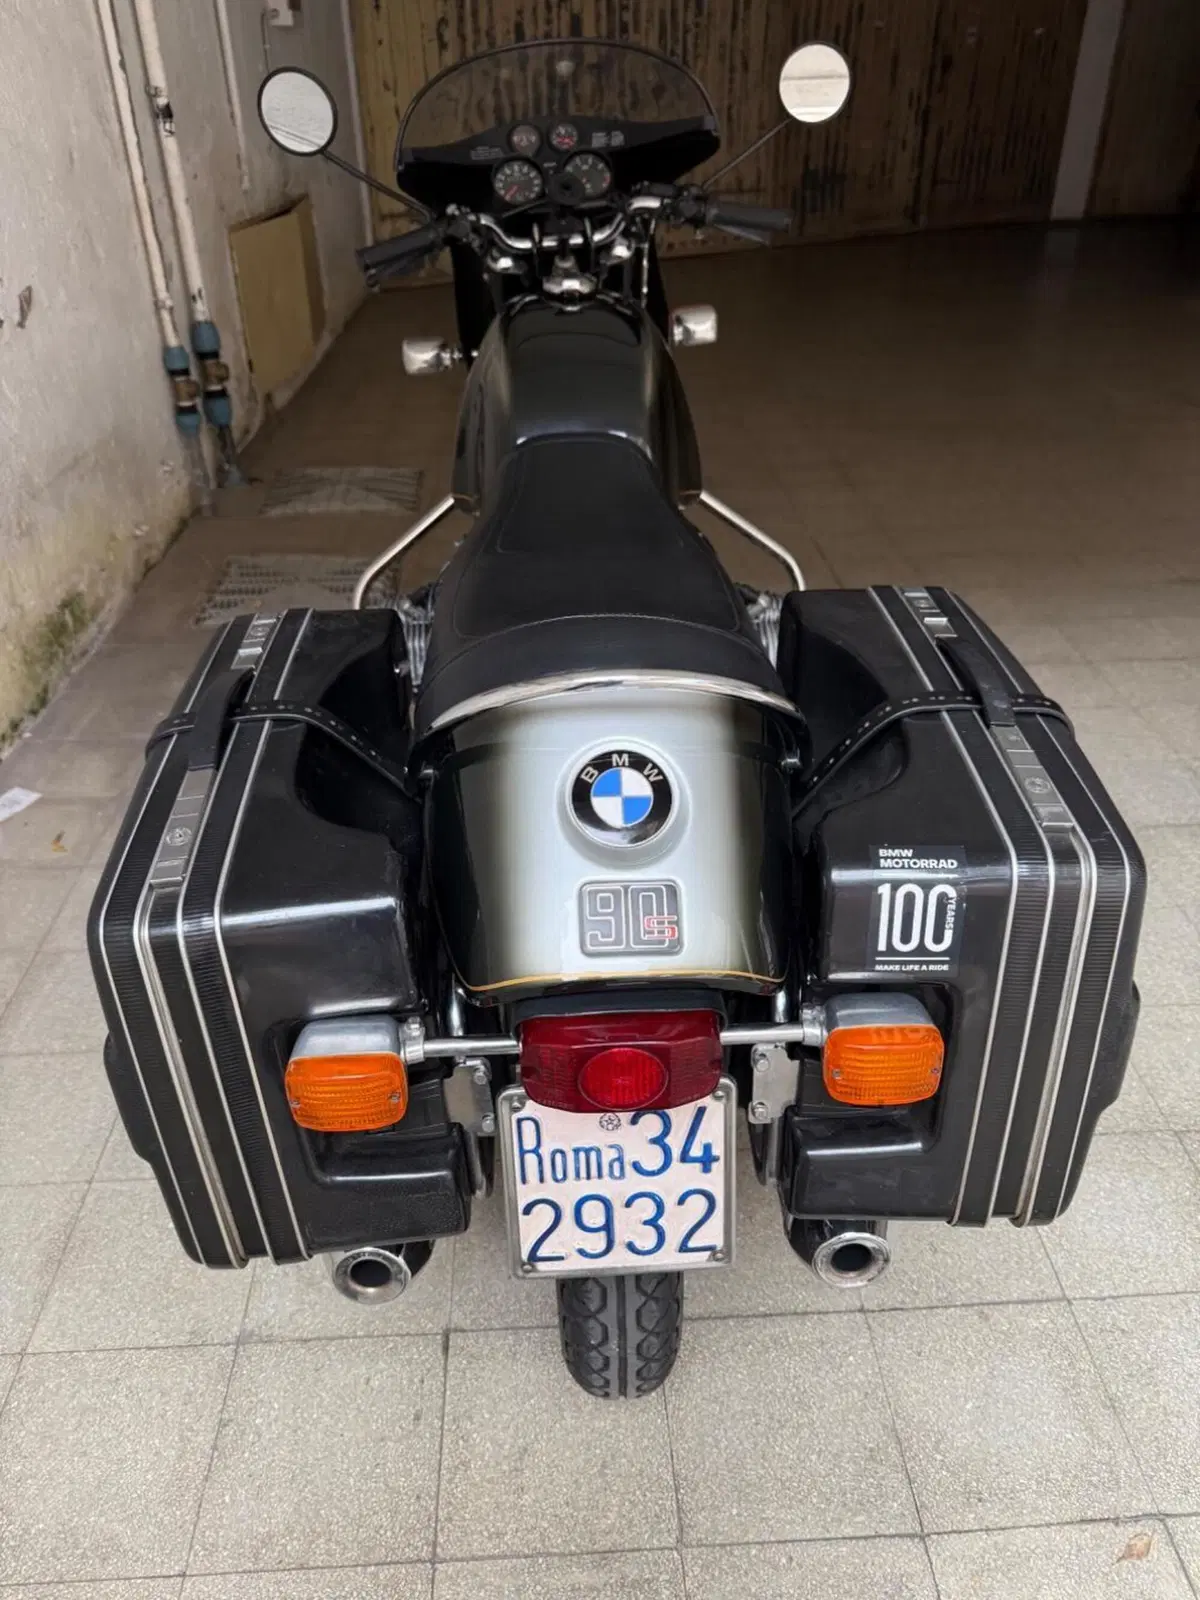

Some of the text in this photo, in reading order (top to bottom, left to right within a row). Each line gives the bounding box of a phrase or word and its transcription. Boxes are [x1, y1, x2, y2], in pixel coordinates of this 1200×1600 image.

[580, 753, 664, 783] BMW
[878, 848, 913, 857] BMW
[880, 858, 958, 869] MOTORRAD
[877, 882, 957, 953] 100
[945, 896, 957, 930] YEARS
[516, 1106, 720, 1185] Roma 34
[522, 1188, 717, 1263] 2932
